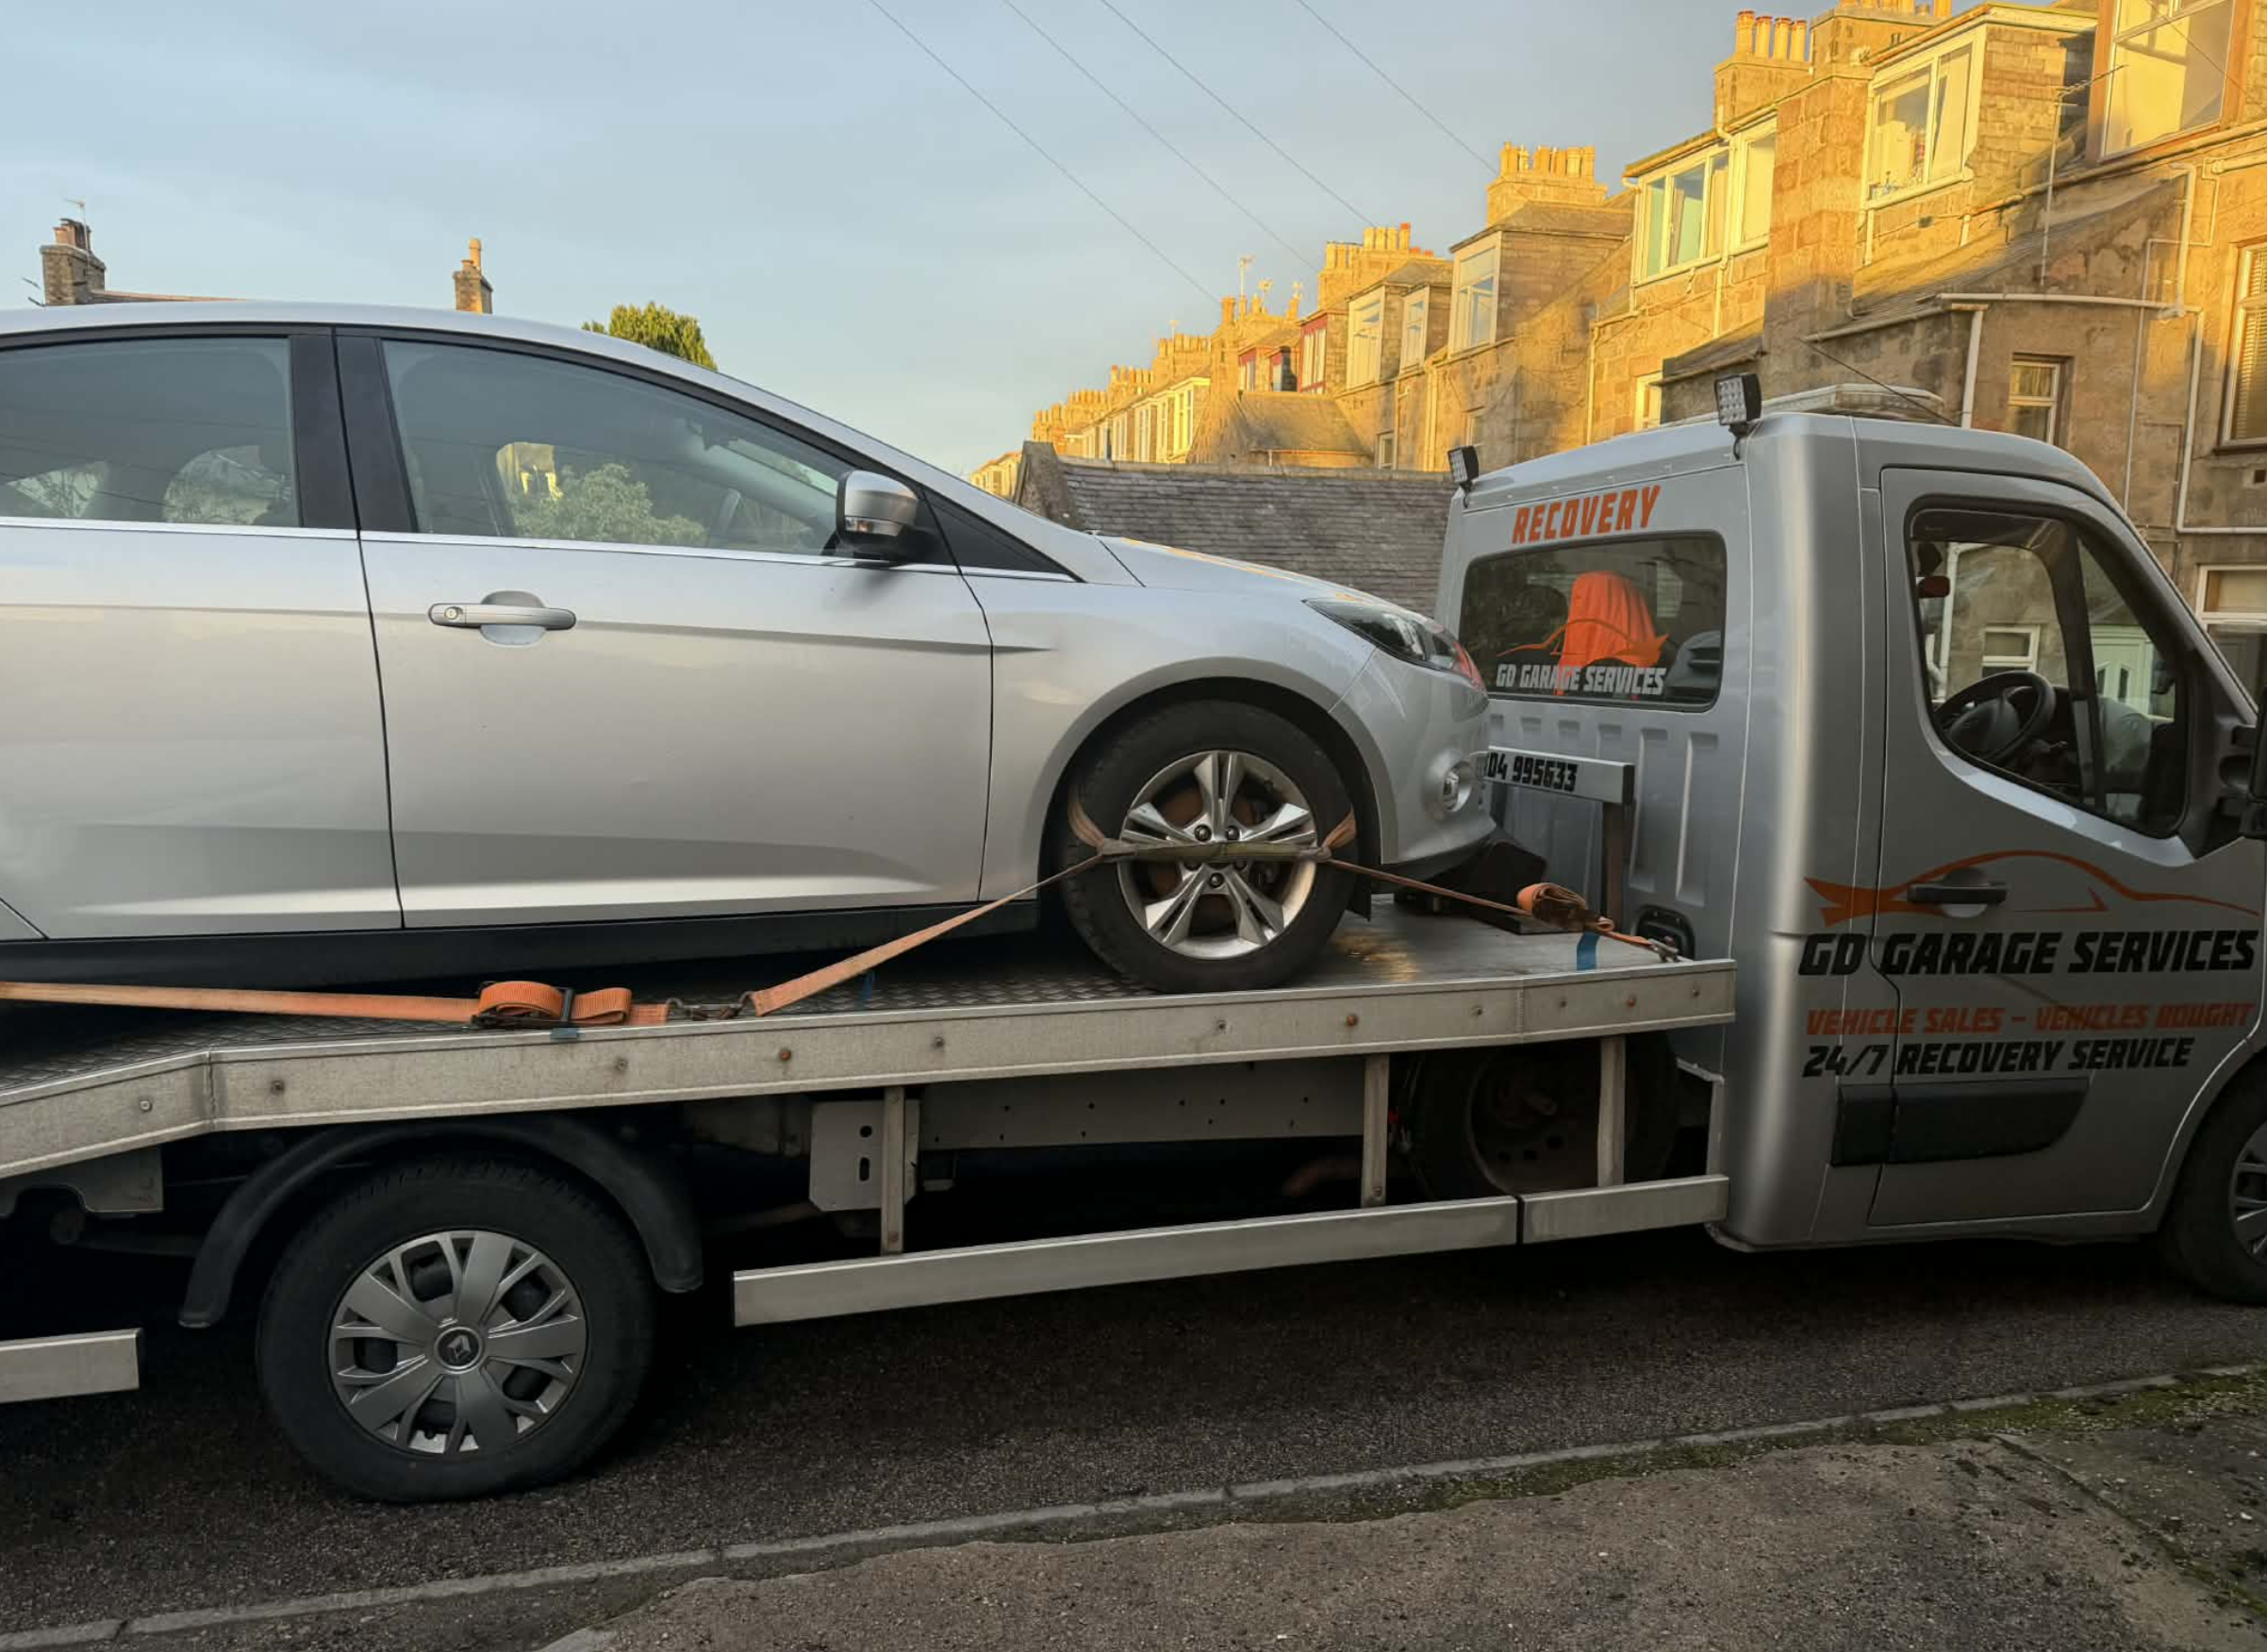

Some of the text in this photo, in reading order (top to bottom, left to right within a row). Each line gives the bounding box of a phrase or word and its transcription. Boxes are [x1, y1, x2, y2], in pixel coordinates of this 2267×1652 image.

[1512, 485, 1661, 544] RECOVERY
[1519, 664, 1581, 691] GARAGE
[1582, 667, 1666, 695] SERVICES
[1880, 932, 2062, 975] GARAGE
[2068, 930, 2259, 973] SERVICES
[1807, 1008, 1918, 1035] VEHICLE
[1924, 1007, 2006, 1033] SALES
[2035, 1004, 2150, 1032] VEHICLES
[1802, 1037, 2195, 1078] 24/7 RECOVERY SERVICE
